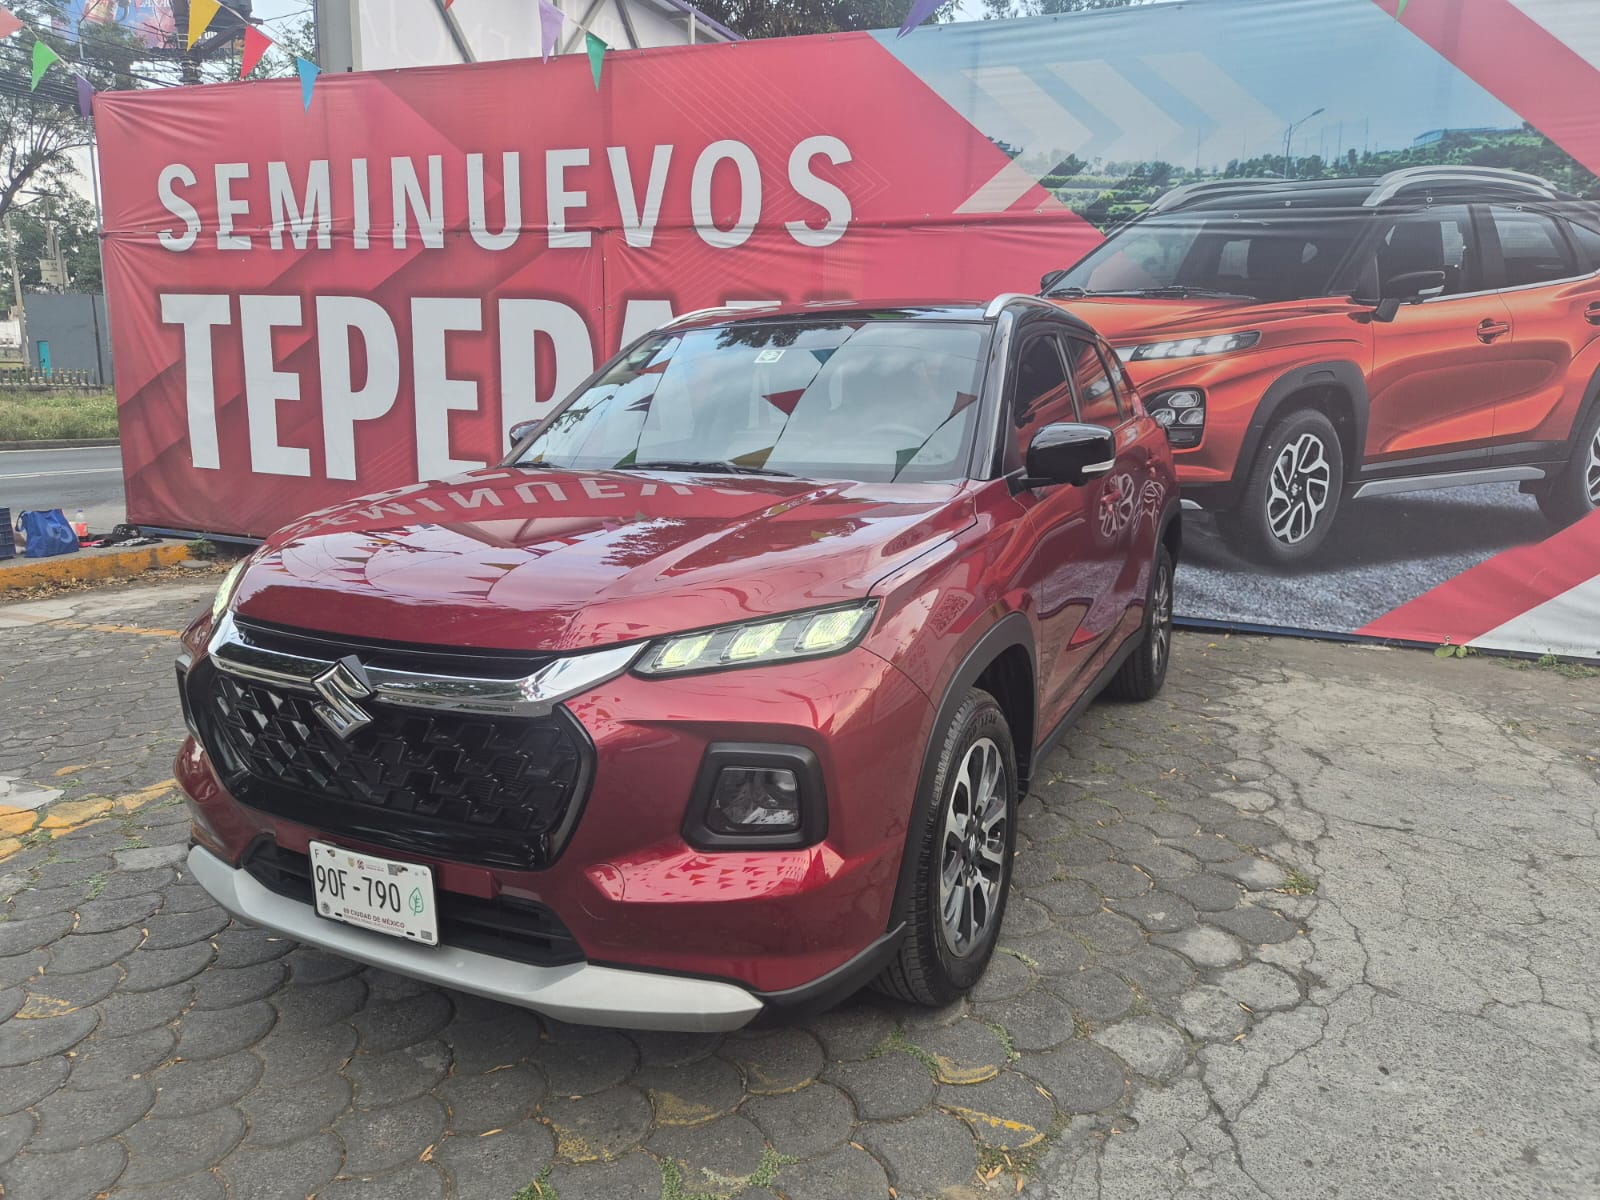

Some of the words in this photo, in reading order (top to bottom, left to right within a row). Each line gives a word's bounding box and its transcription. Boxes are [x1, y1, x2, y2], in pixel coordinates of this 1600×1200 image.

[156, 134, 853, 252] SEMINUEVOS
[160, 293, 783, 483] TEPEP
[315, 864, 401, 913] 90F-790
[350, 909, 372, 920] CIUDAD
[372, 915, 381, 923] DE
[381, 917, 405, 929] MÉXICO
